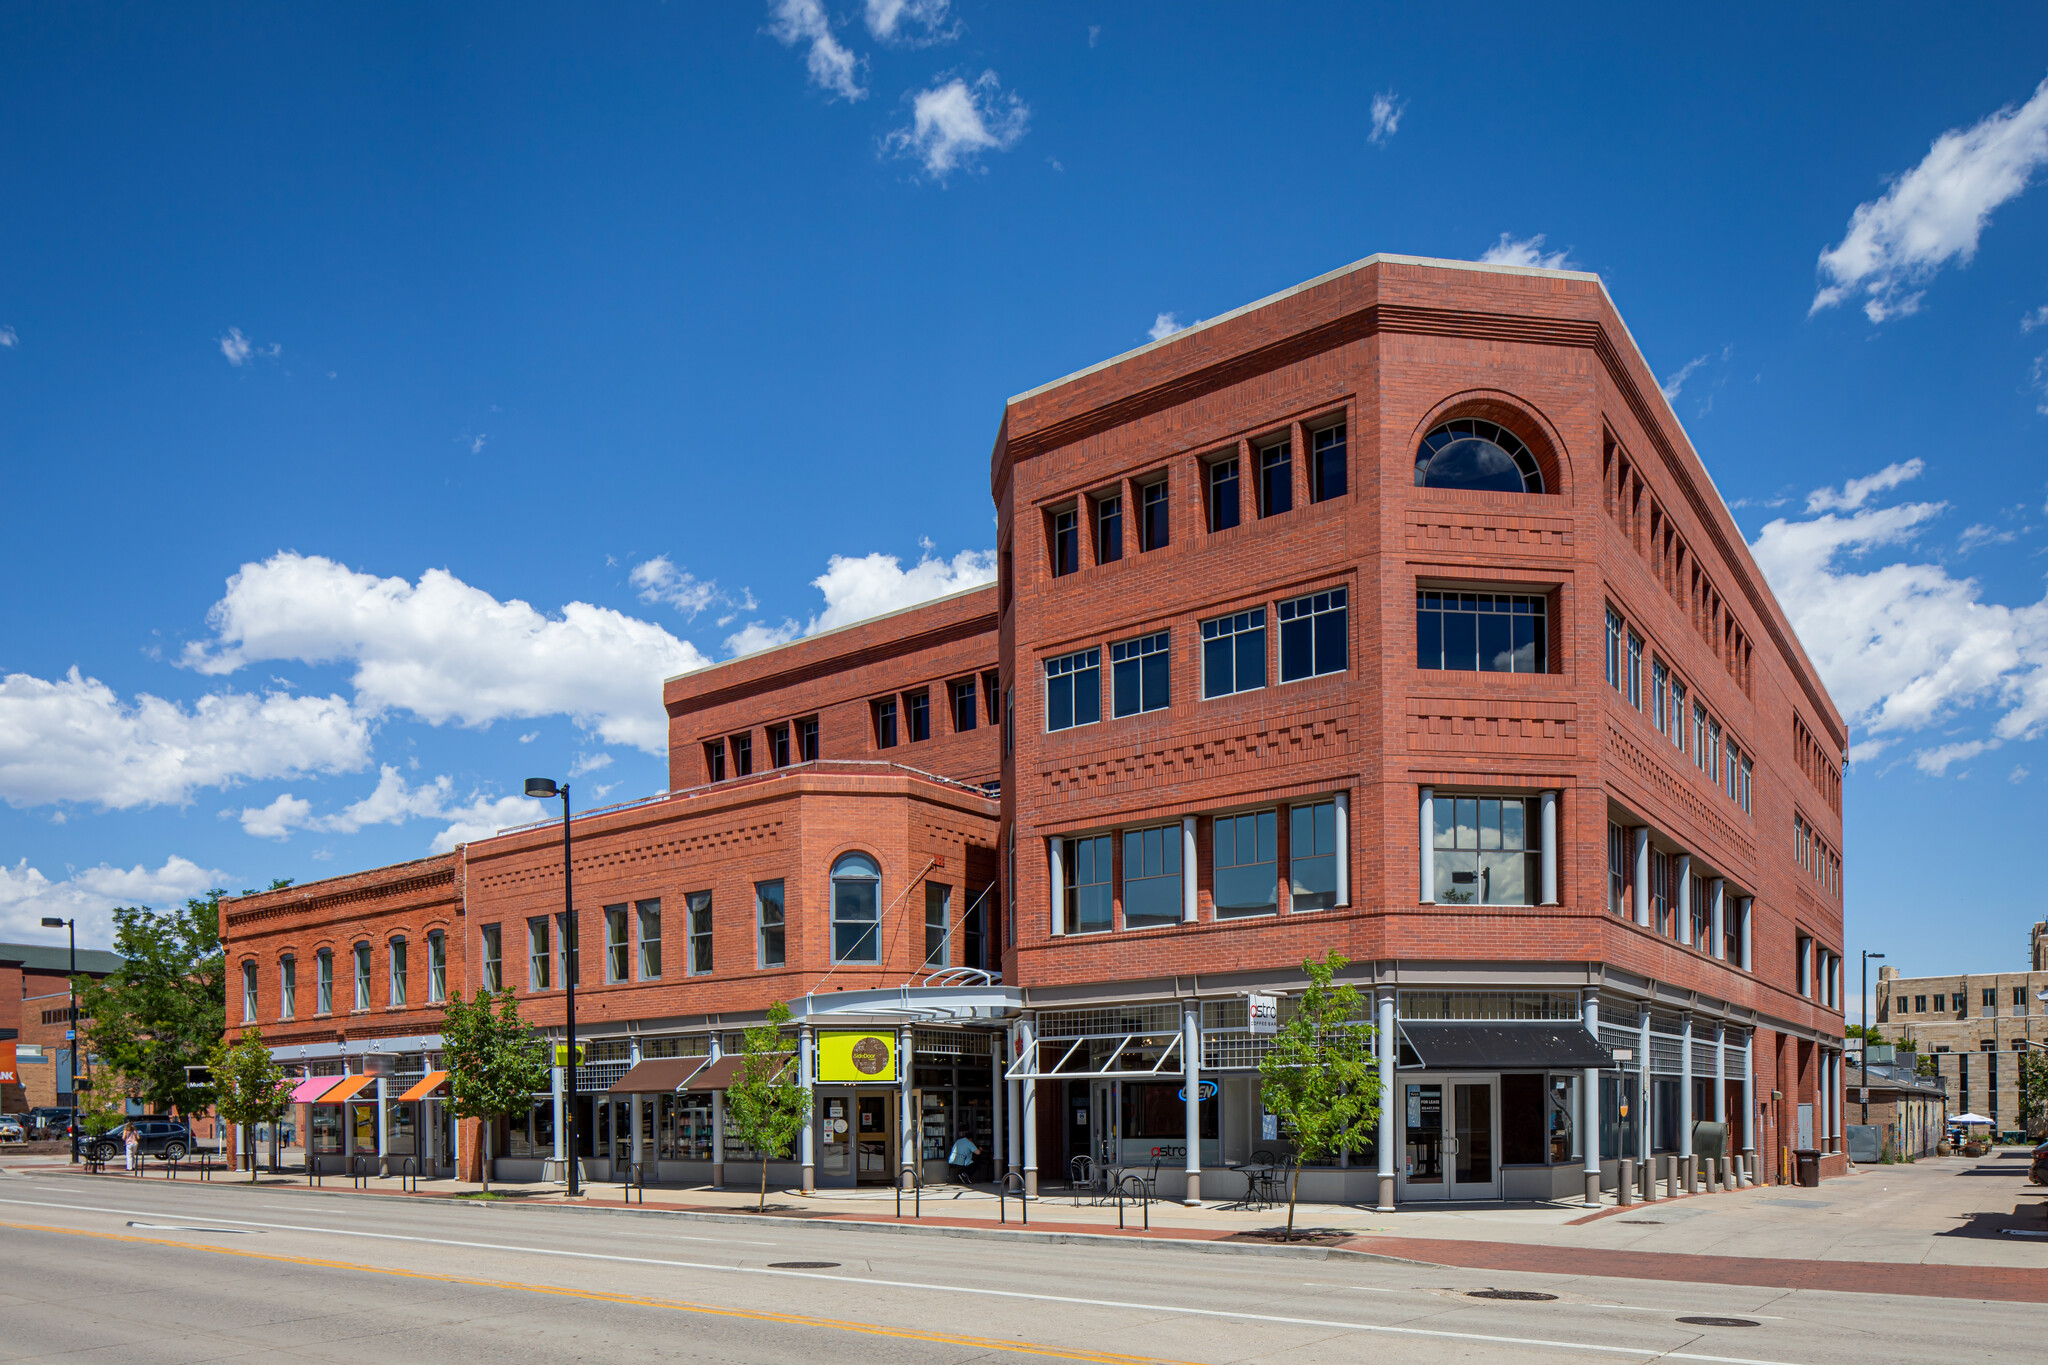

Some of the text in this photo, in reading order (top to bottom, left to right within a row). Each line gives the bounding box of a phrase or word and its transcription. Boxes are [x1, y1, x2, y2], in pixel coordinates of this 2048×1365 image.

[1250, 1003, 1277, 1019] astro
[0, 1071, 14, 1081] NK
[1151, 1144, 1187, 1157] astro
